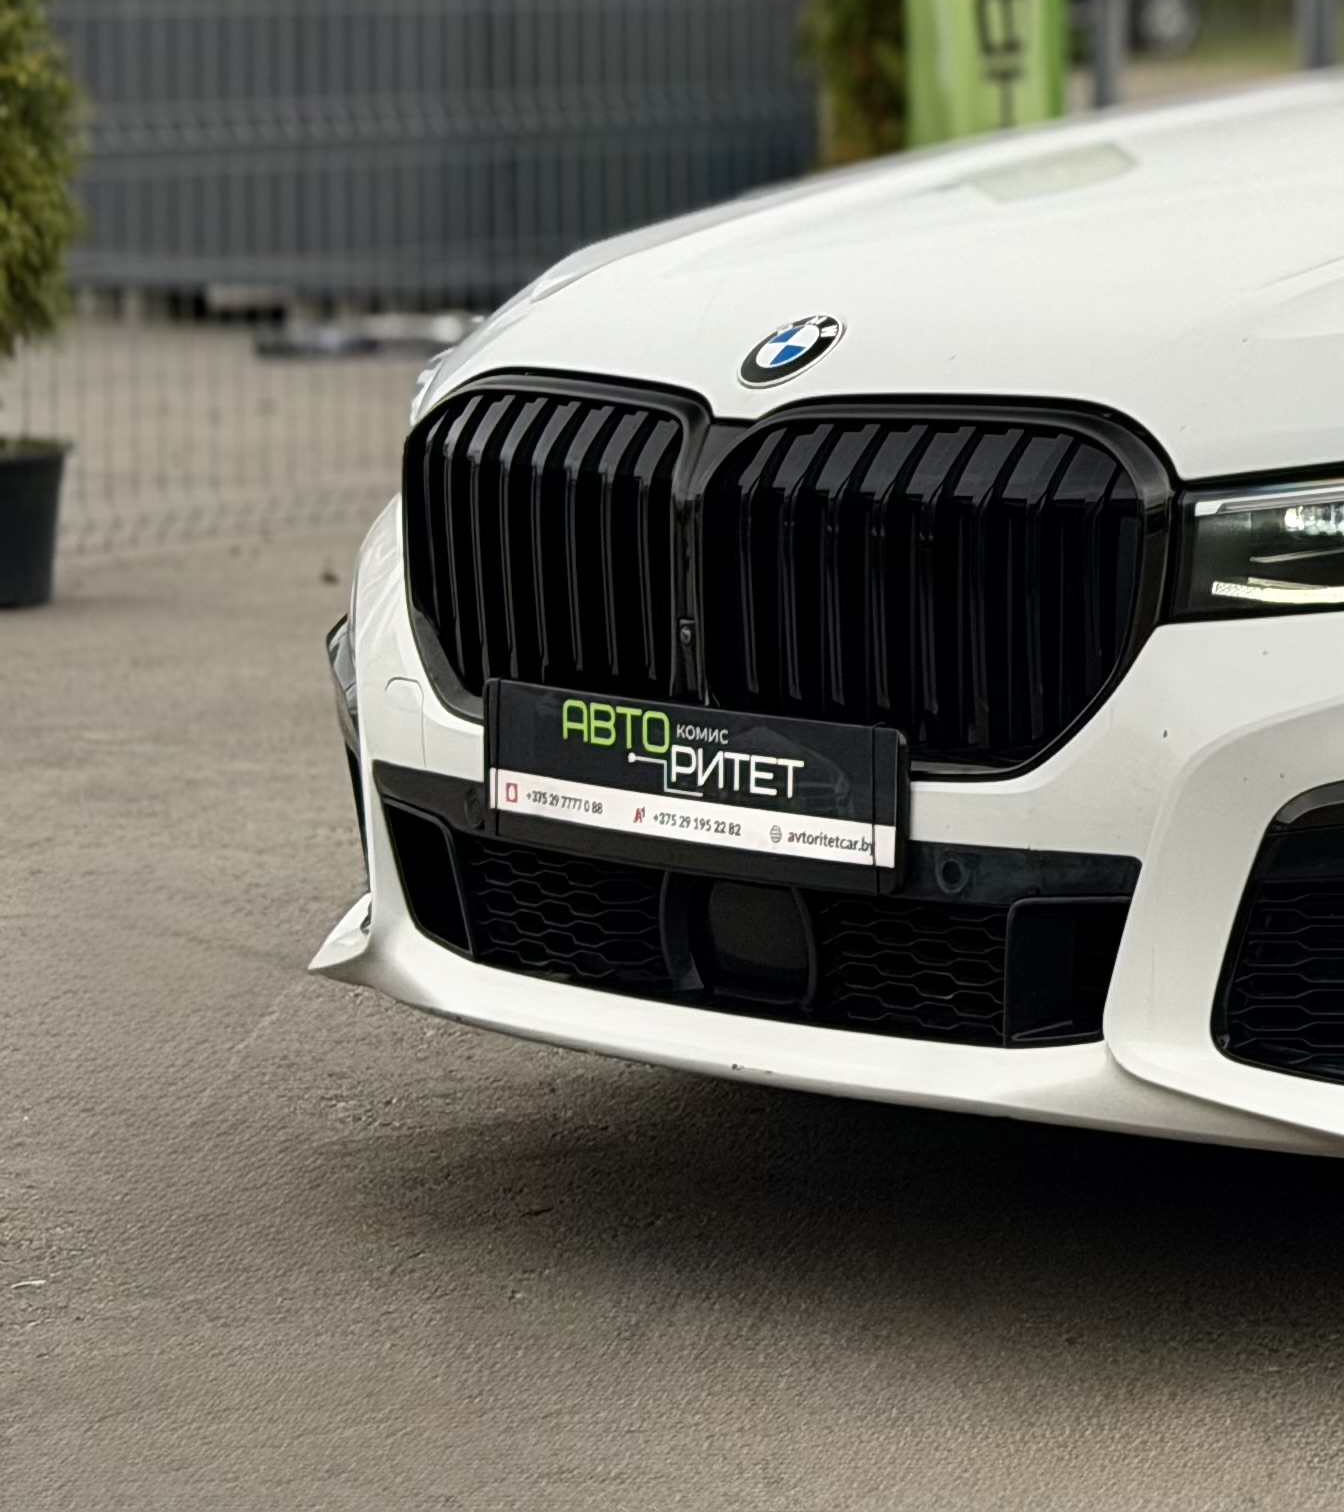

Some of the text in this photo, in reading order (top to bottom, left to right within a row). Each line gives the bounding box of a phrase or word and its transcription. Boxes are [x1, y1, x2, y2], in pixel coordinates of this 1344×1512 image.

[562, 699, 670, 754] АВТО
[676, 723, 729, 745] КОМИС
[671, 744, 805, 800] РИТЕТ
[653, 812, 677, 827] +375
[679, 815, 691, 829] 29
[714, 820, 726, 834] 22
